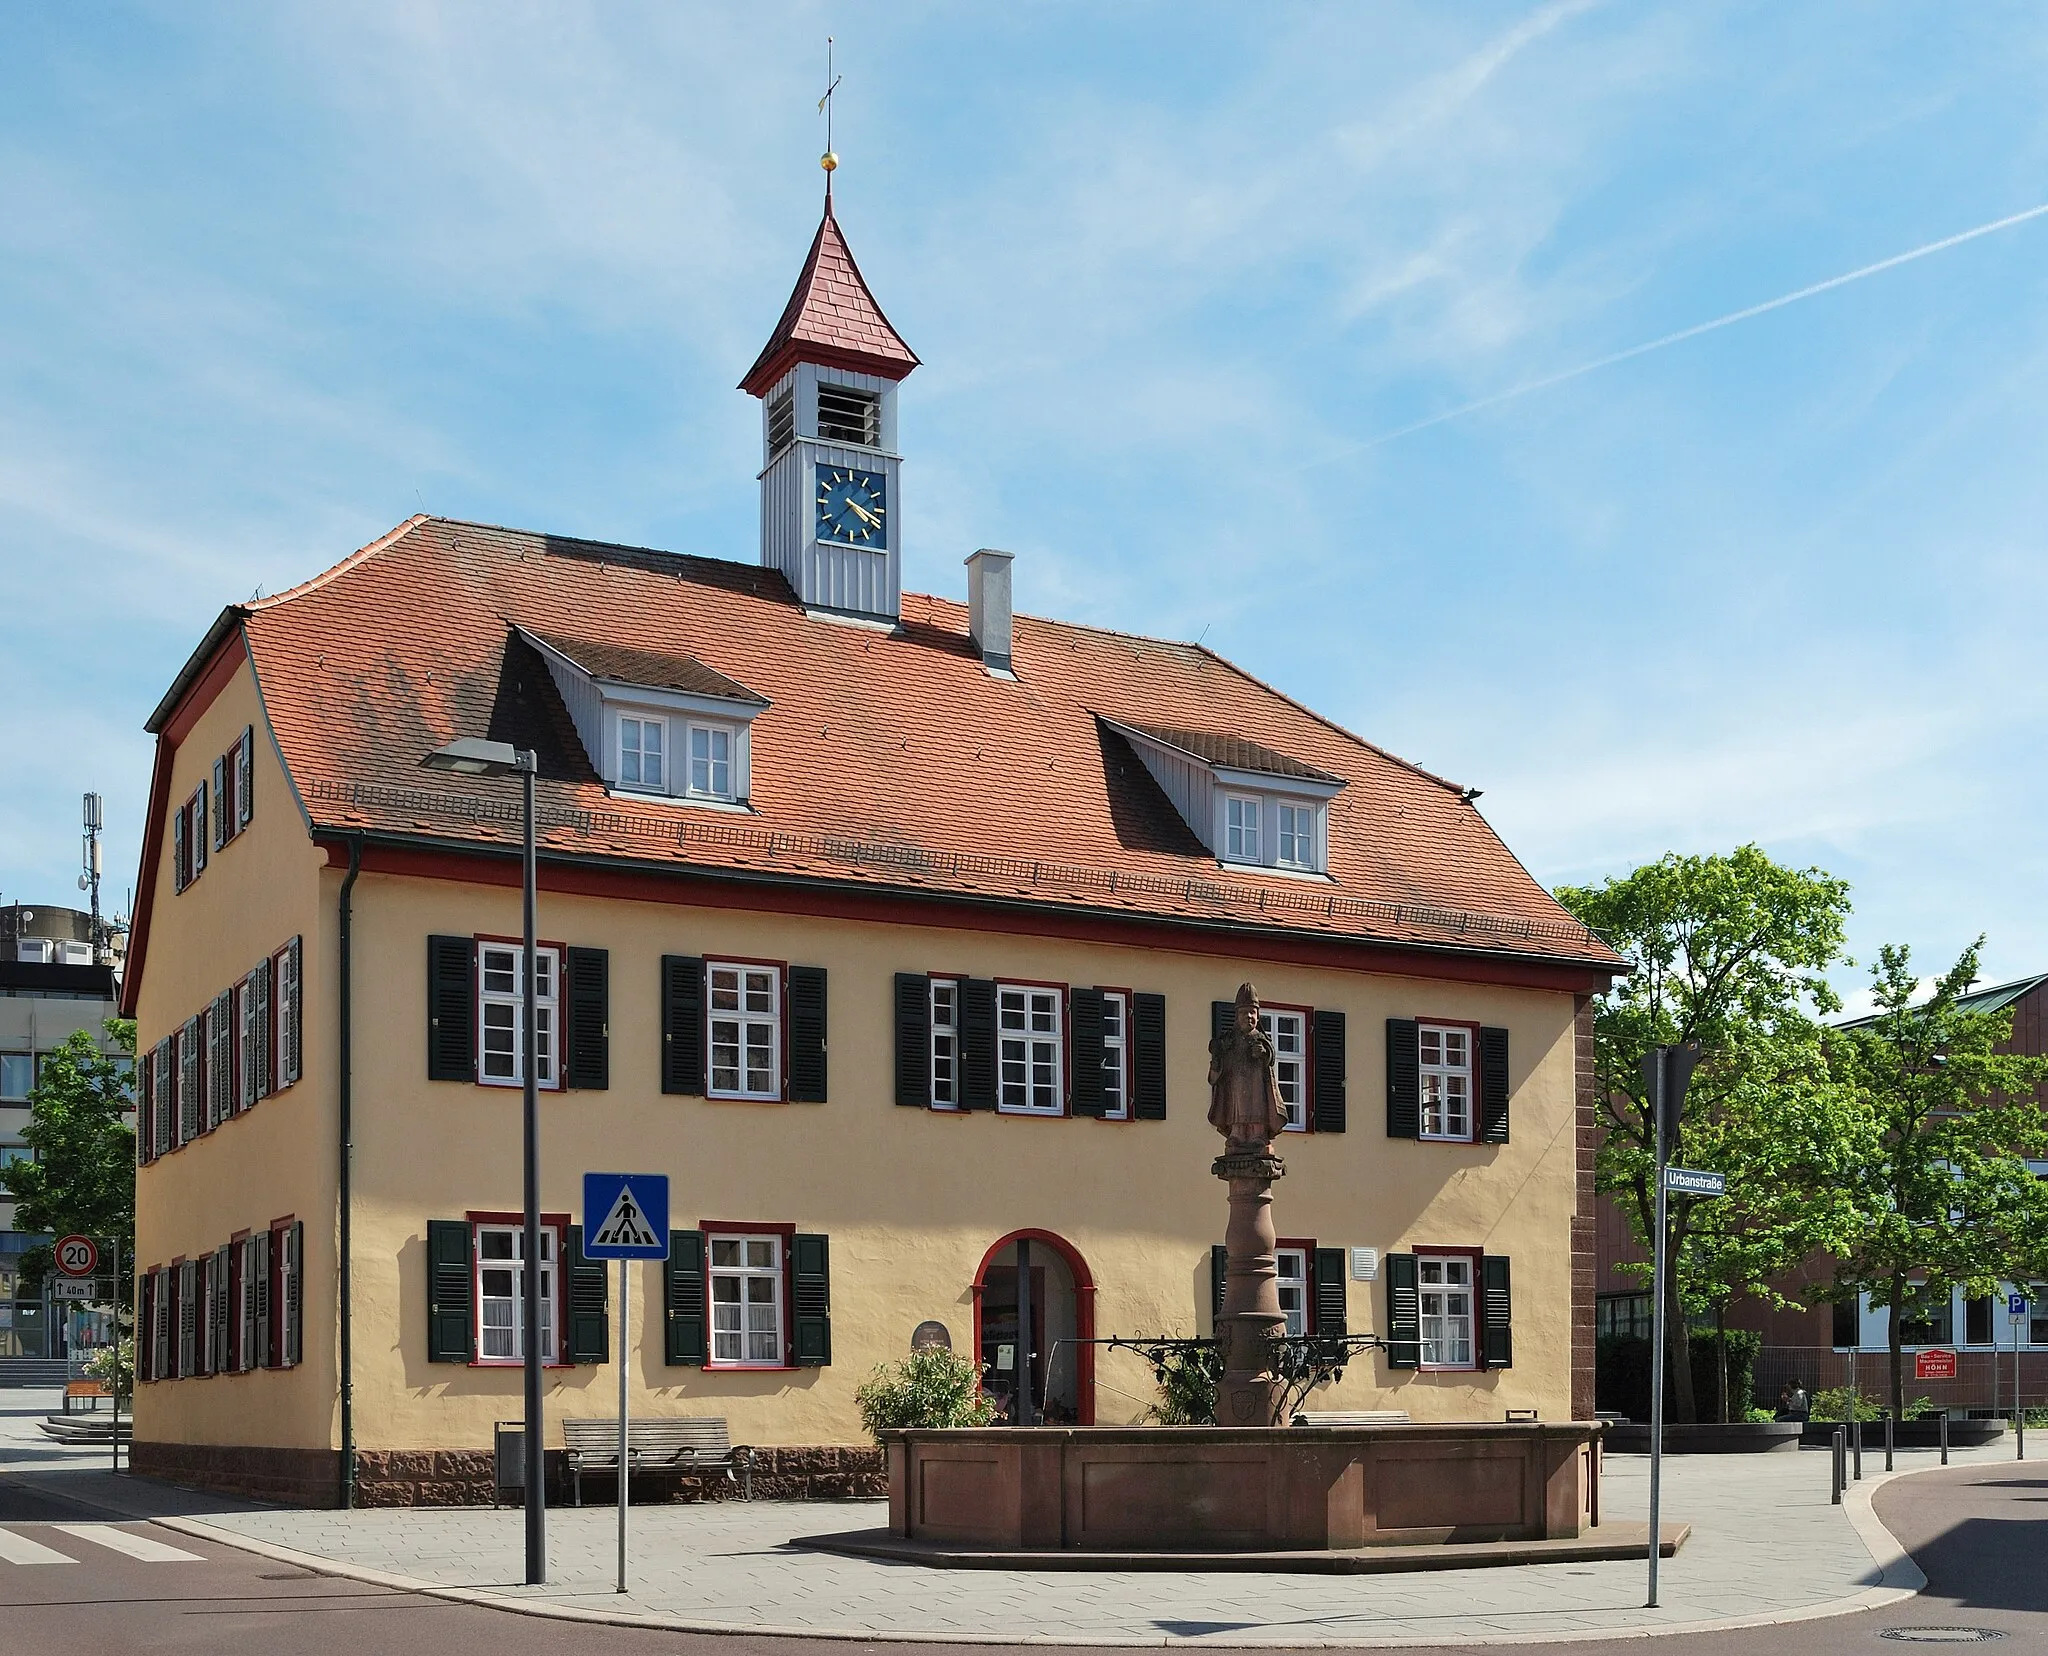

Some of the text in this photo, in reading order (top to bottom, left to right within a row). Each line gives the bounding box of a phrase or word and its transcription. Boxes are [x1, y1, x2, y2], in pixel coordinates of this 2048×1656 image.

[1669, 1172, 1722, 1189] Urbanstraße
[66, 1246, 89, 1265] 20
[2012, 1297, 2021, 1311] P
